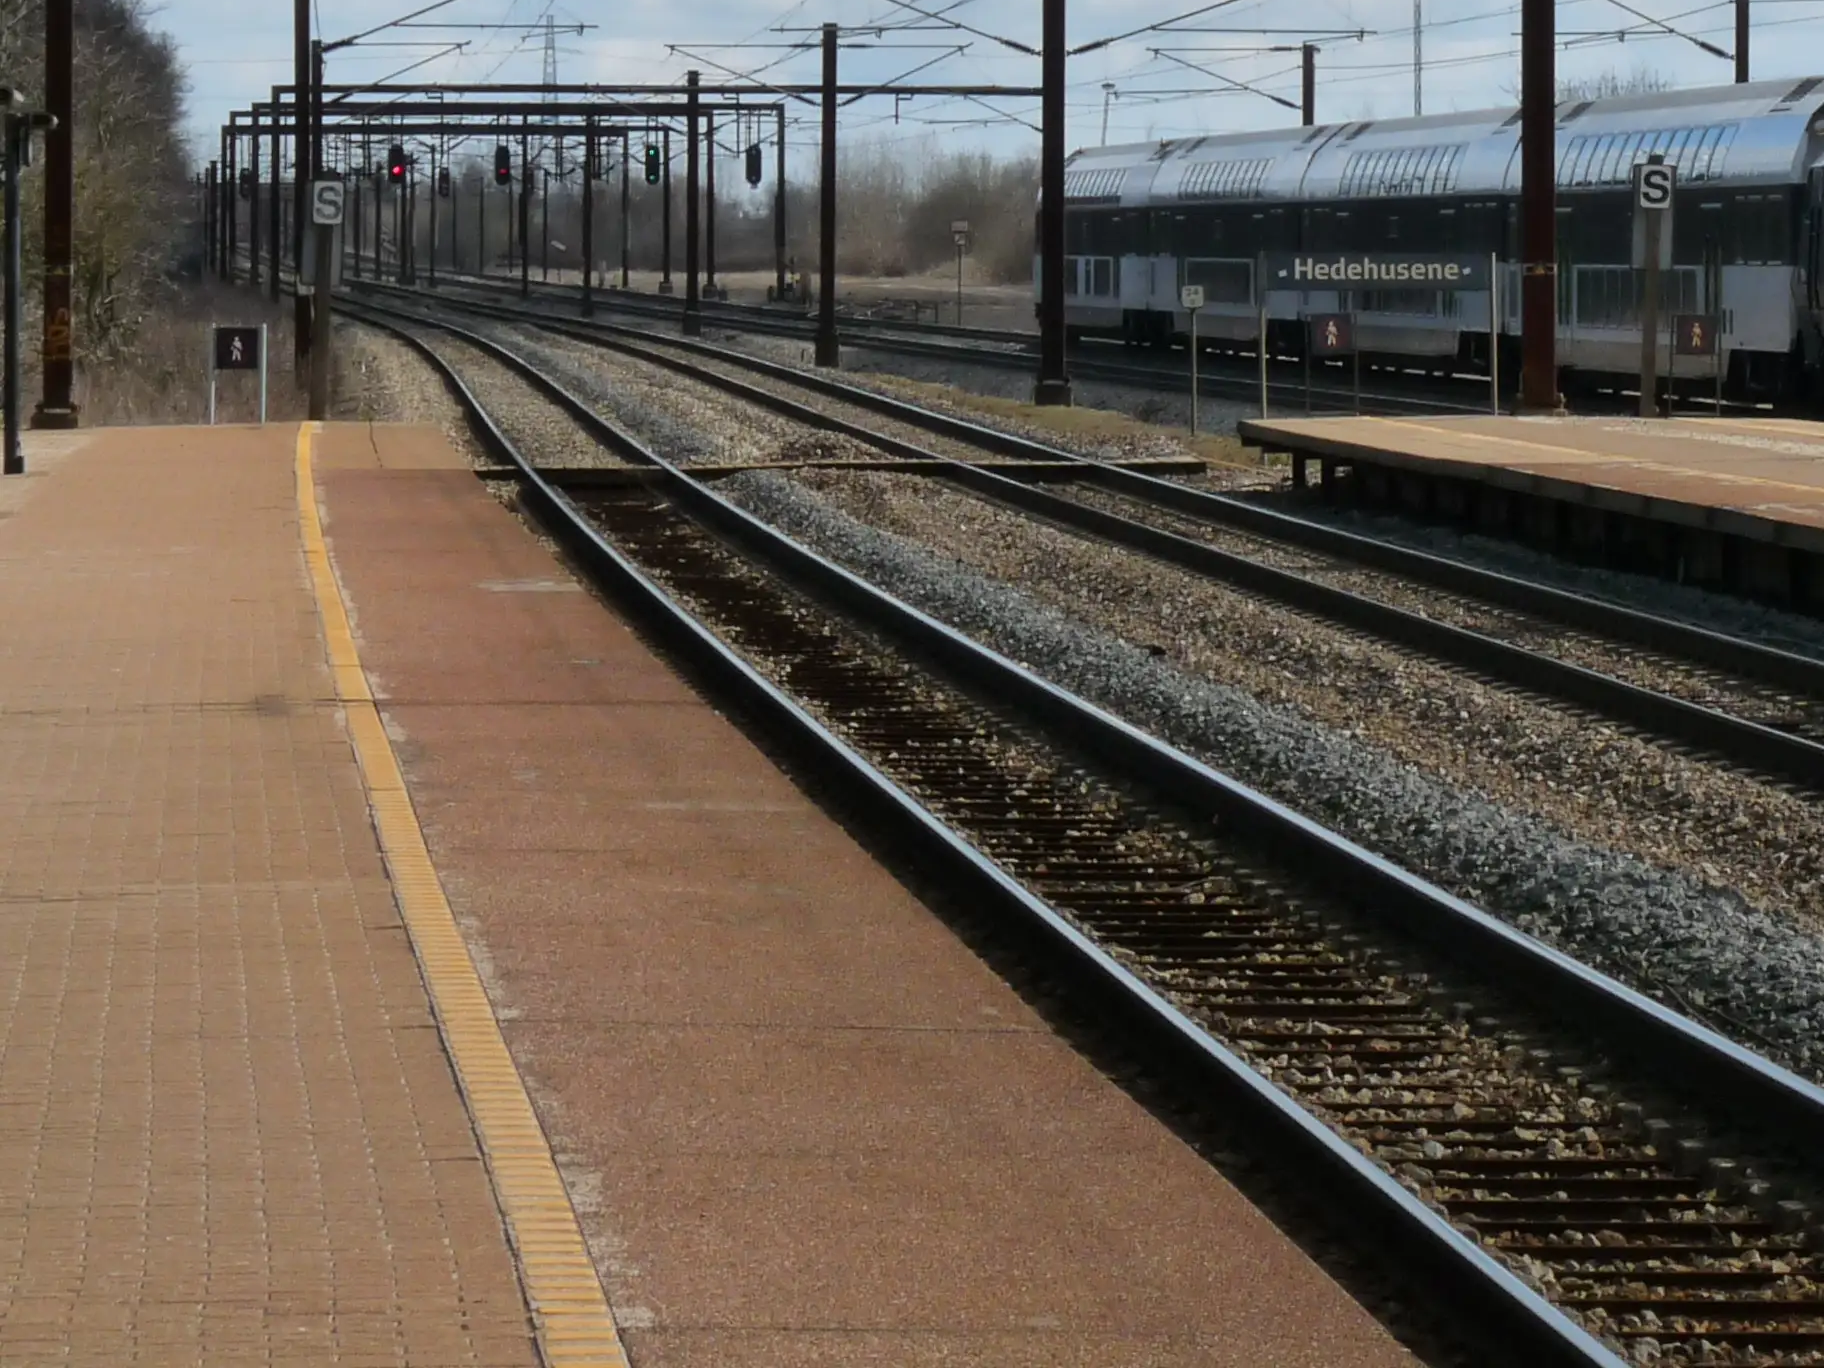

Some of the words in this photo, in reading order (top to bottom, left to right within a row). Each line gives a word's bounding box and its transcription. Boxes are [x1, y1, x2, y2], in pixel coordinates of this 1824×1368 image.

[317, 186, 342, 220] S
[1643, 170, 1670, 204] S
[1294, 257, 1459, 280] Hedehusene
